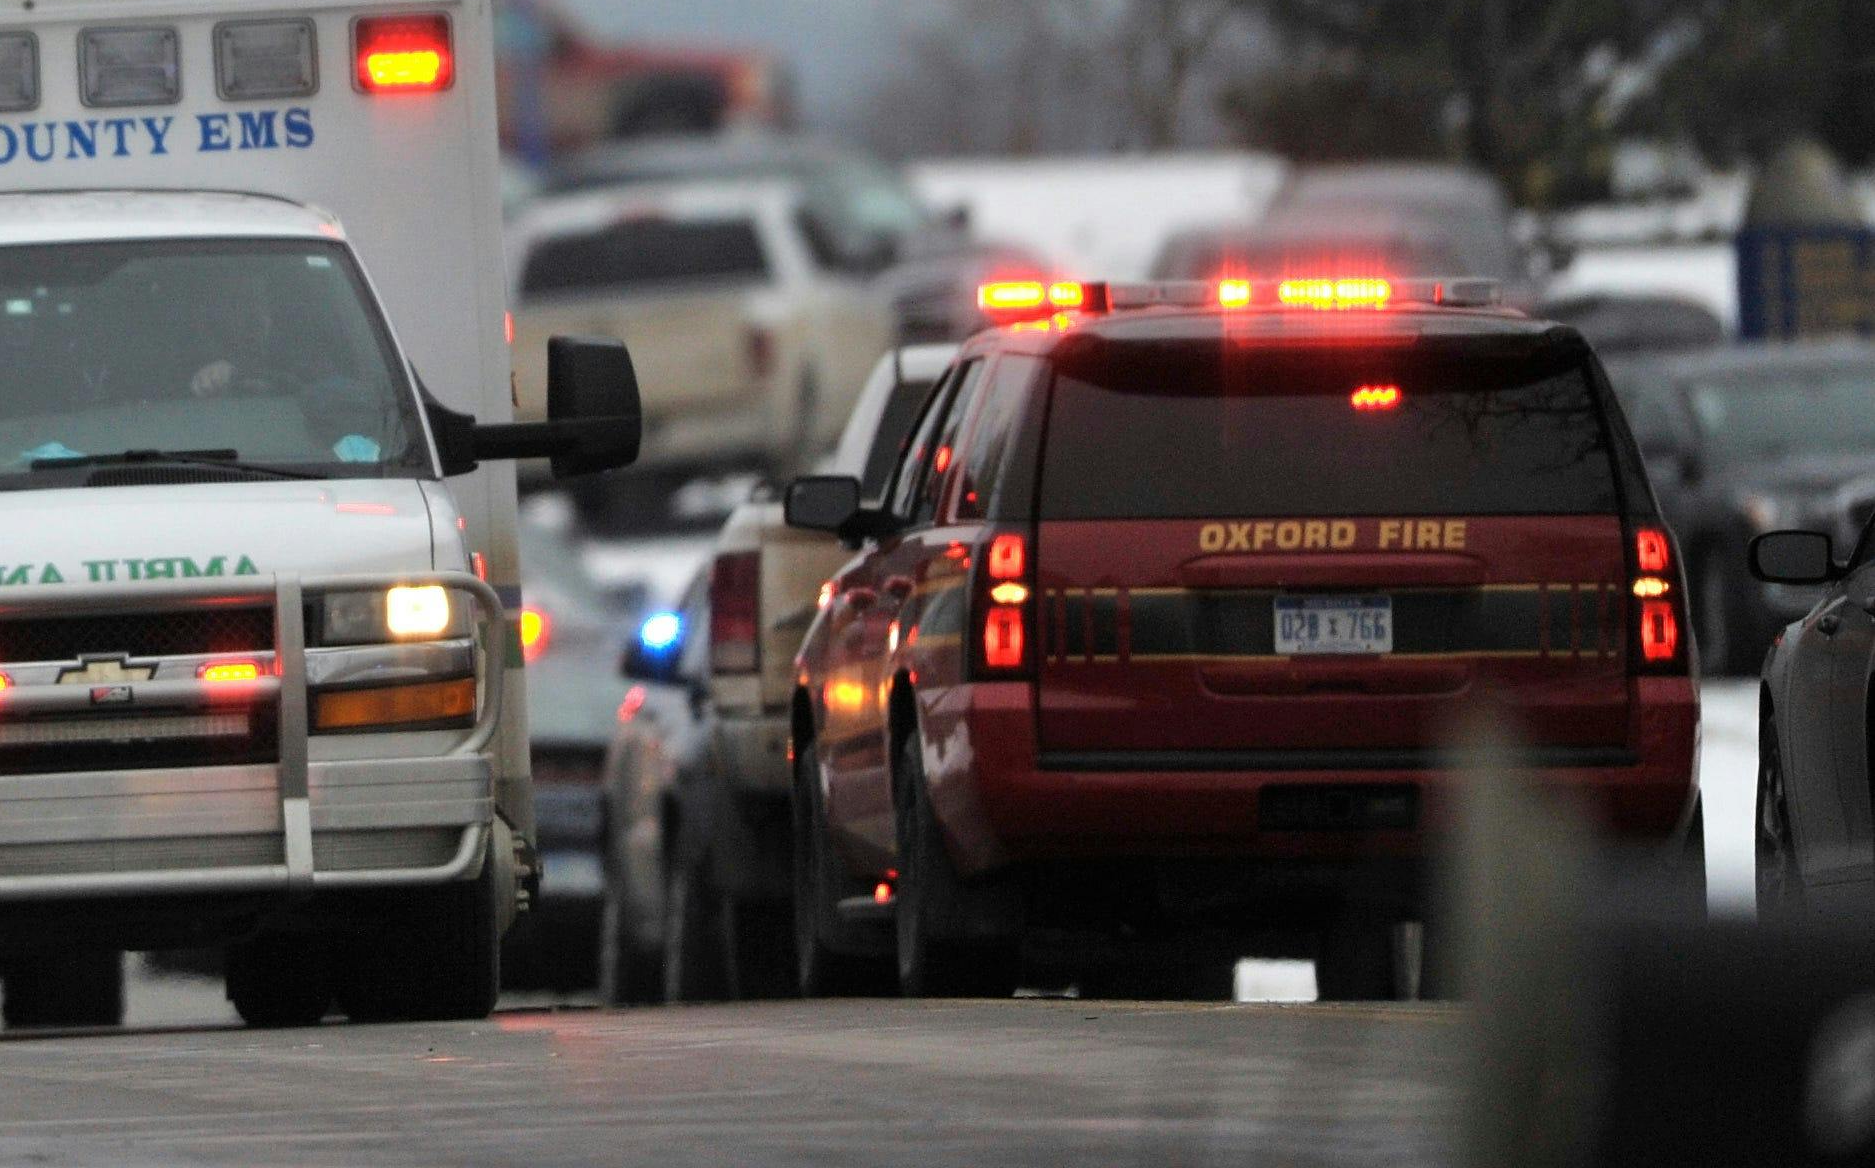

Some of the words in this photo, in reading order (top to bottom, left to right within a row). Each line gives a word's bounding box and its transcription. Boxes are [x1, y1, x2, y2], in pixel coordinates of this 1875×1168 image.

[195, 107, 315, 153] EMS
[1199, 520, 1357, 552] OXFORD
[1379, 519, 1467, 550] FIRE
